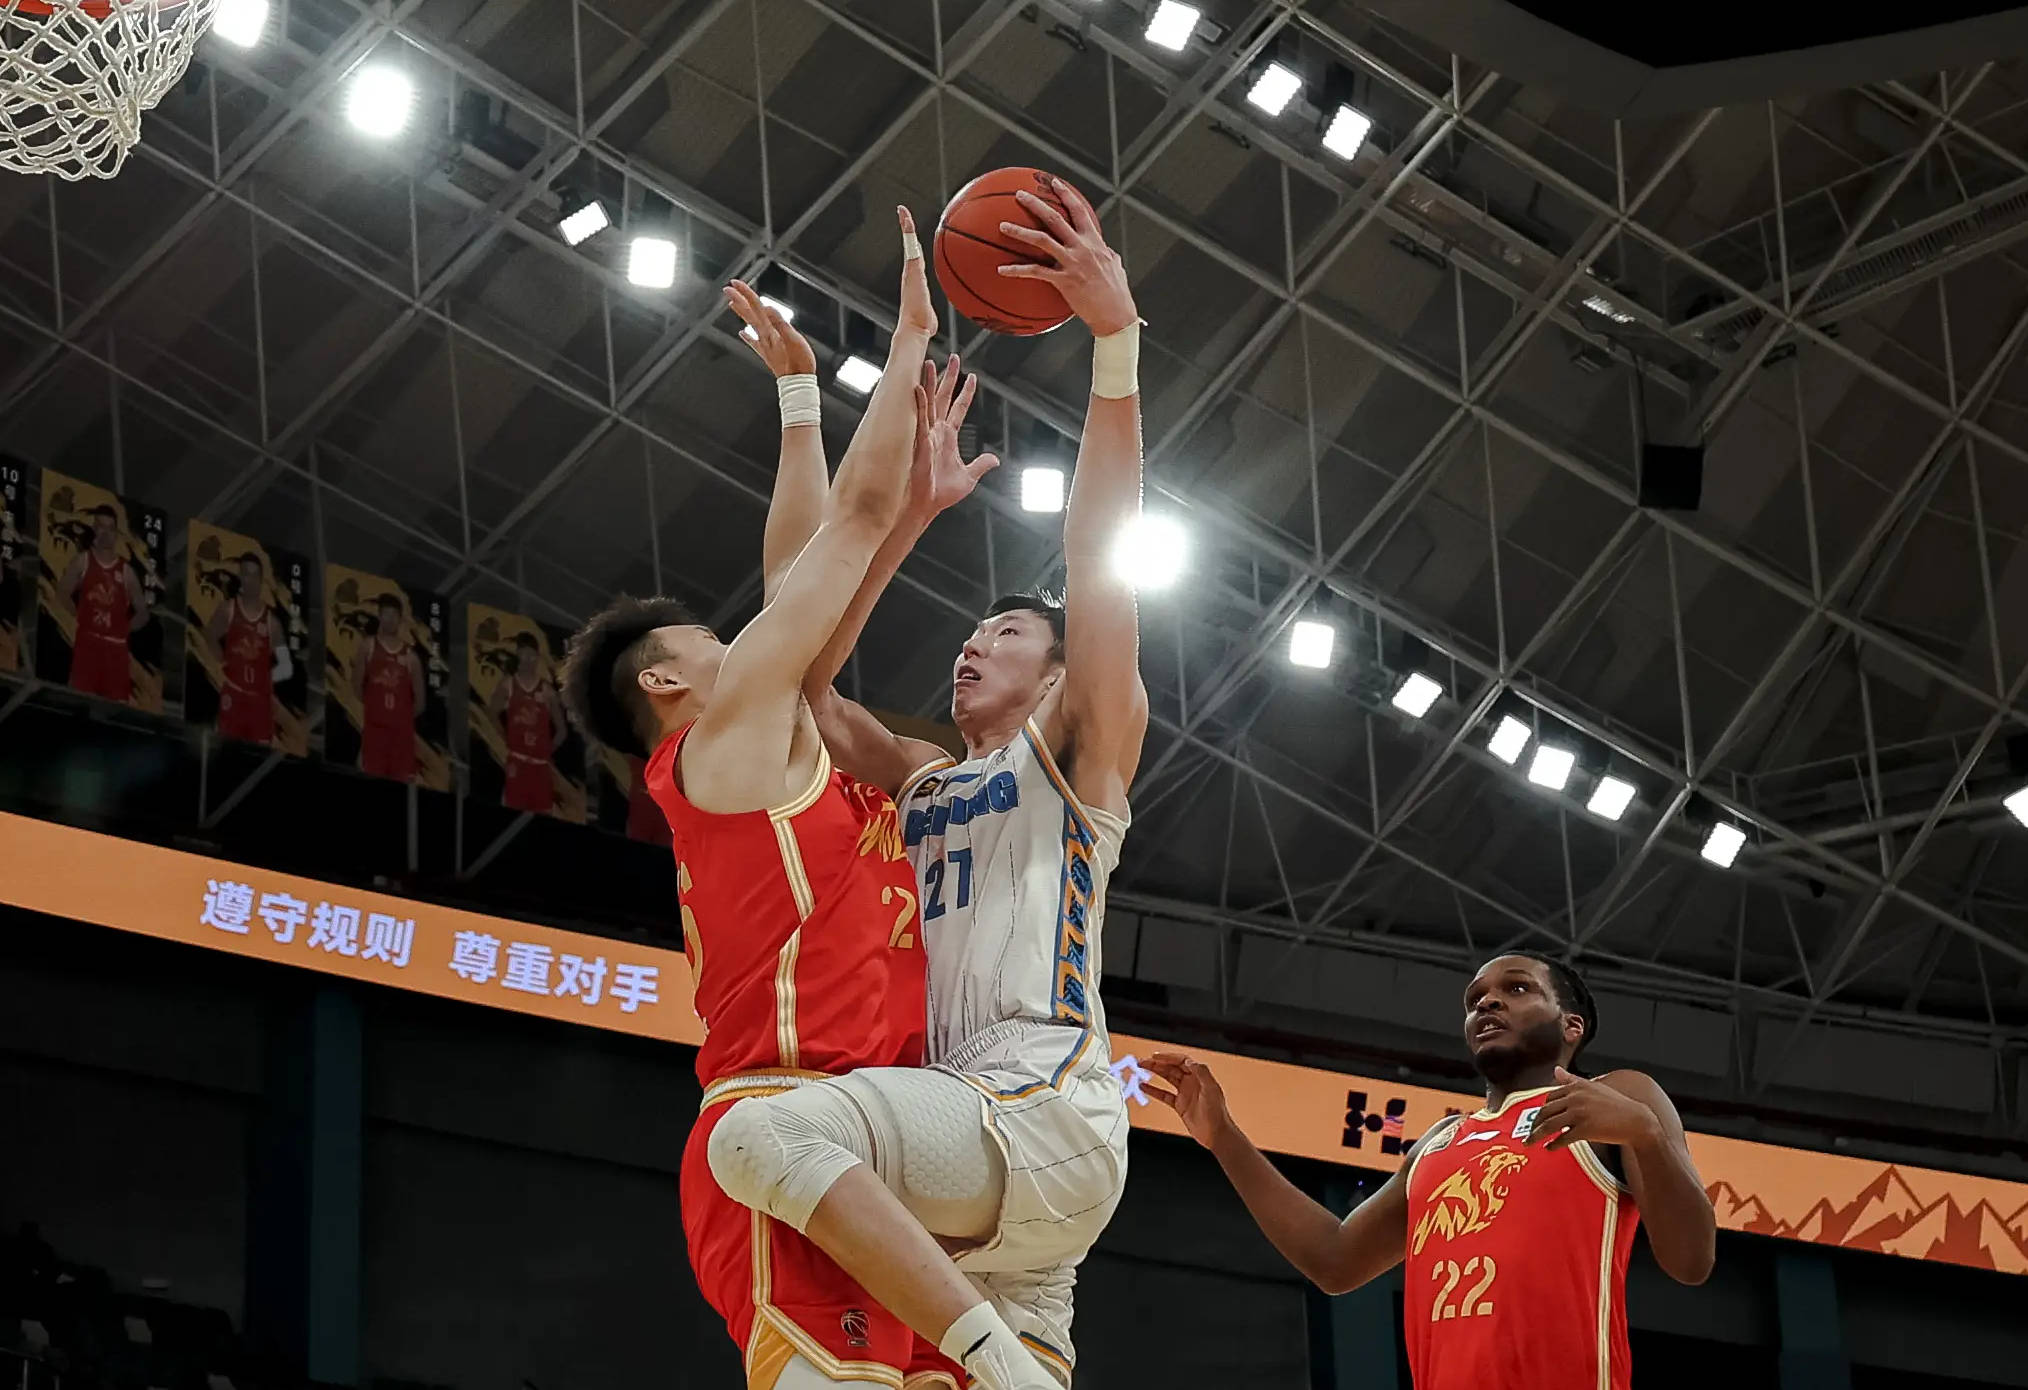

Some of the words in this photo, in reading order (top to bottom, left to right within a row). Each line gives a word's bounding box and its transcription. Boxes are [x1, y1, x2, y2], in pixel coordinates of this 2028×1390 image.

[924, 847, 972, 922] 27
[200, 879, 416, 968] 遵守规则
[448, 930, 659, 1012] 尊重对手
[1431, 1255, 1496, 1322] 22
